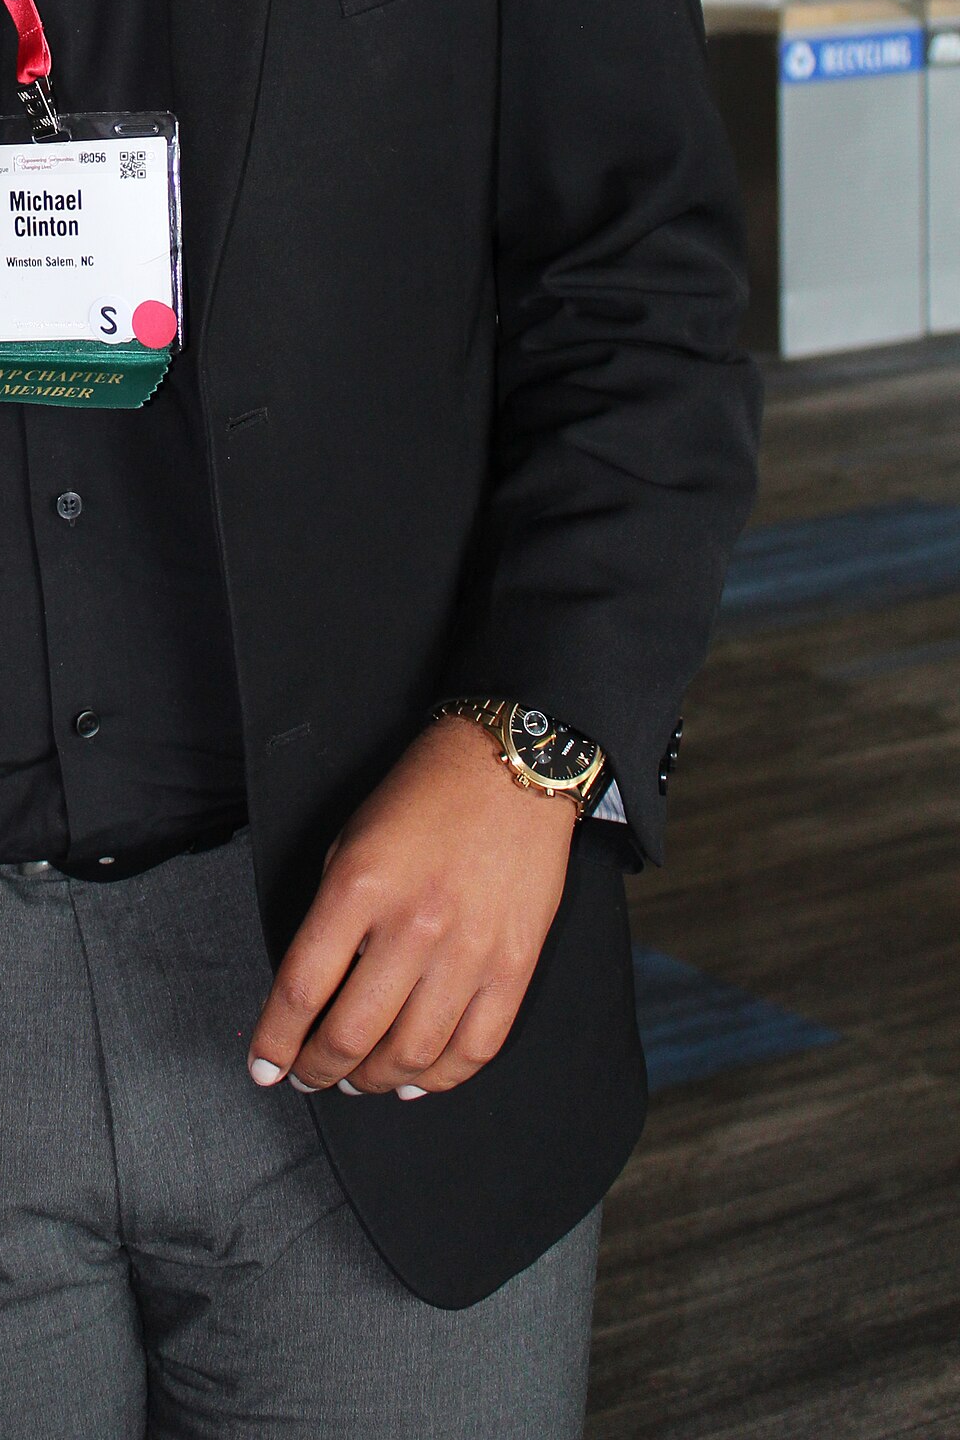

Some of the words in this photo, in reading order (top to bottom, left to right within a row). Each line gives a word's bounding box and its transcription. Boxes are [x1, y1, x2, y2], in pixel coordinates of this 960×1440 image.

[10, 189, 82, 211] Michael
[14, 216, 79, 237] Clinton
[6, 257, 43, 267] Winston
[45, 256, 78, 268] Salem,
[81, 255, 94, 266] NC
[100, 306, 117, 335] S
[24, 369, 124, 384] CHAPTER
